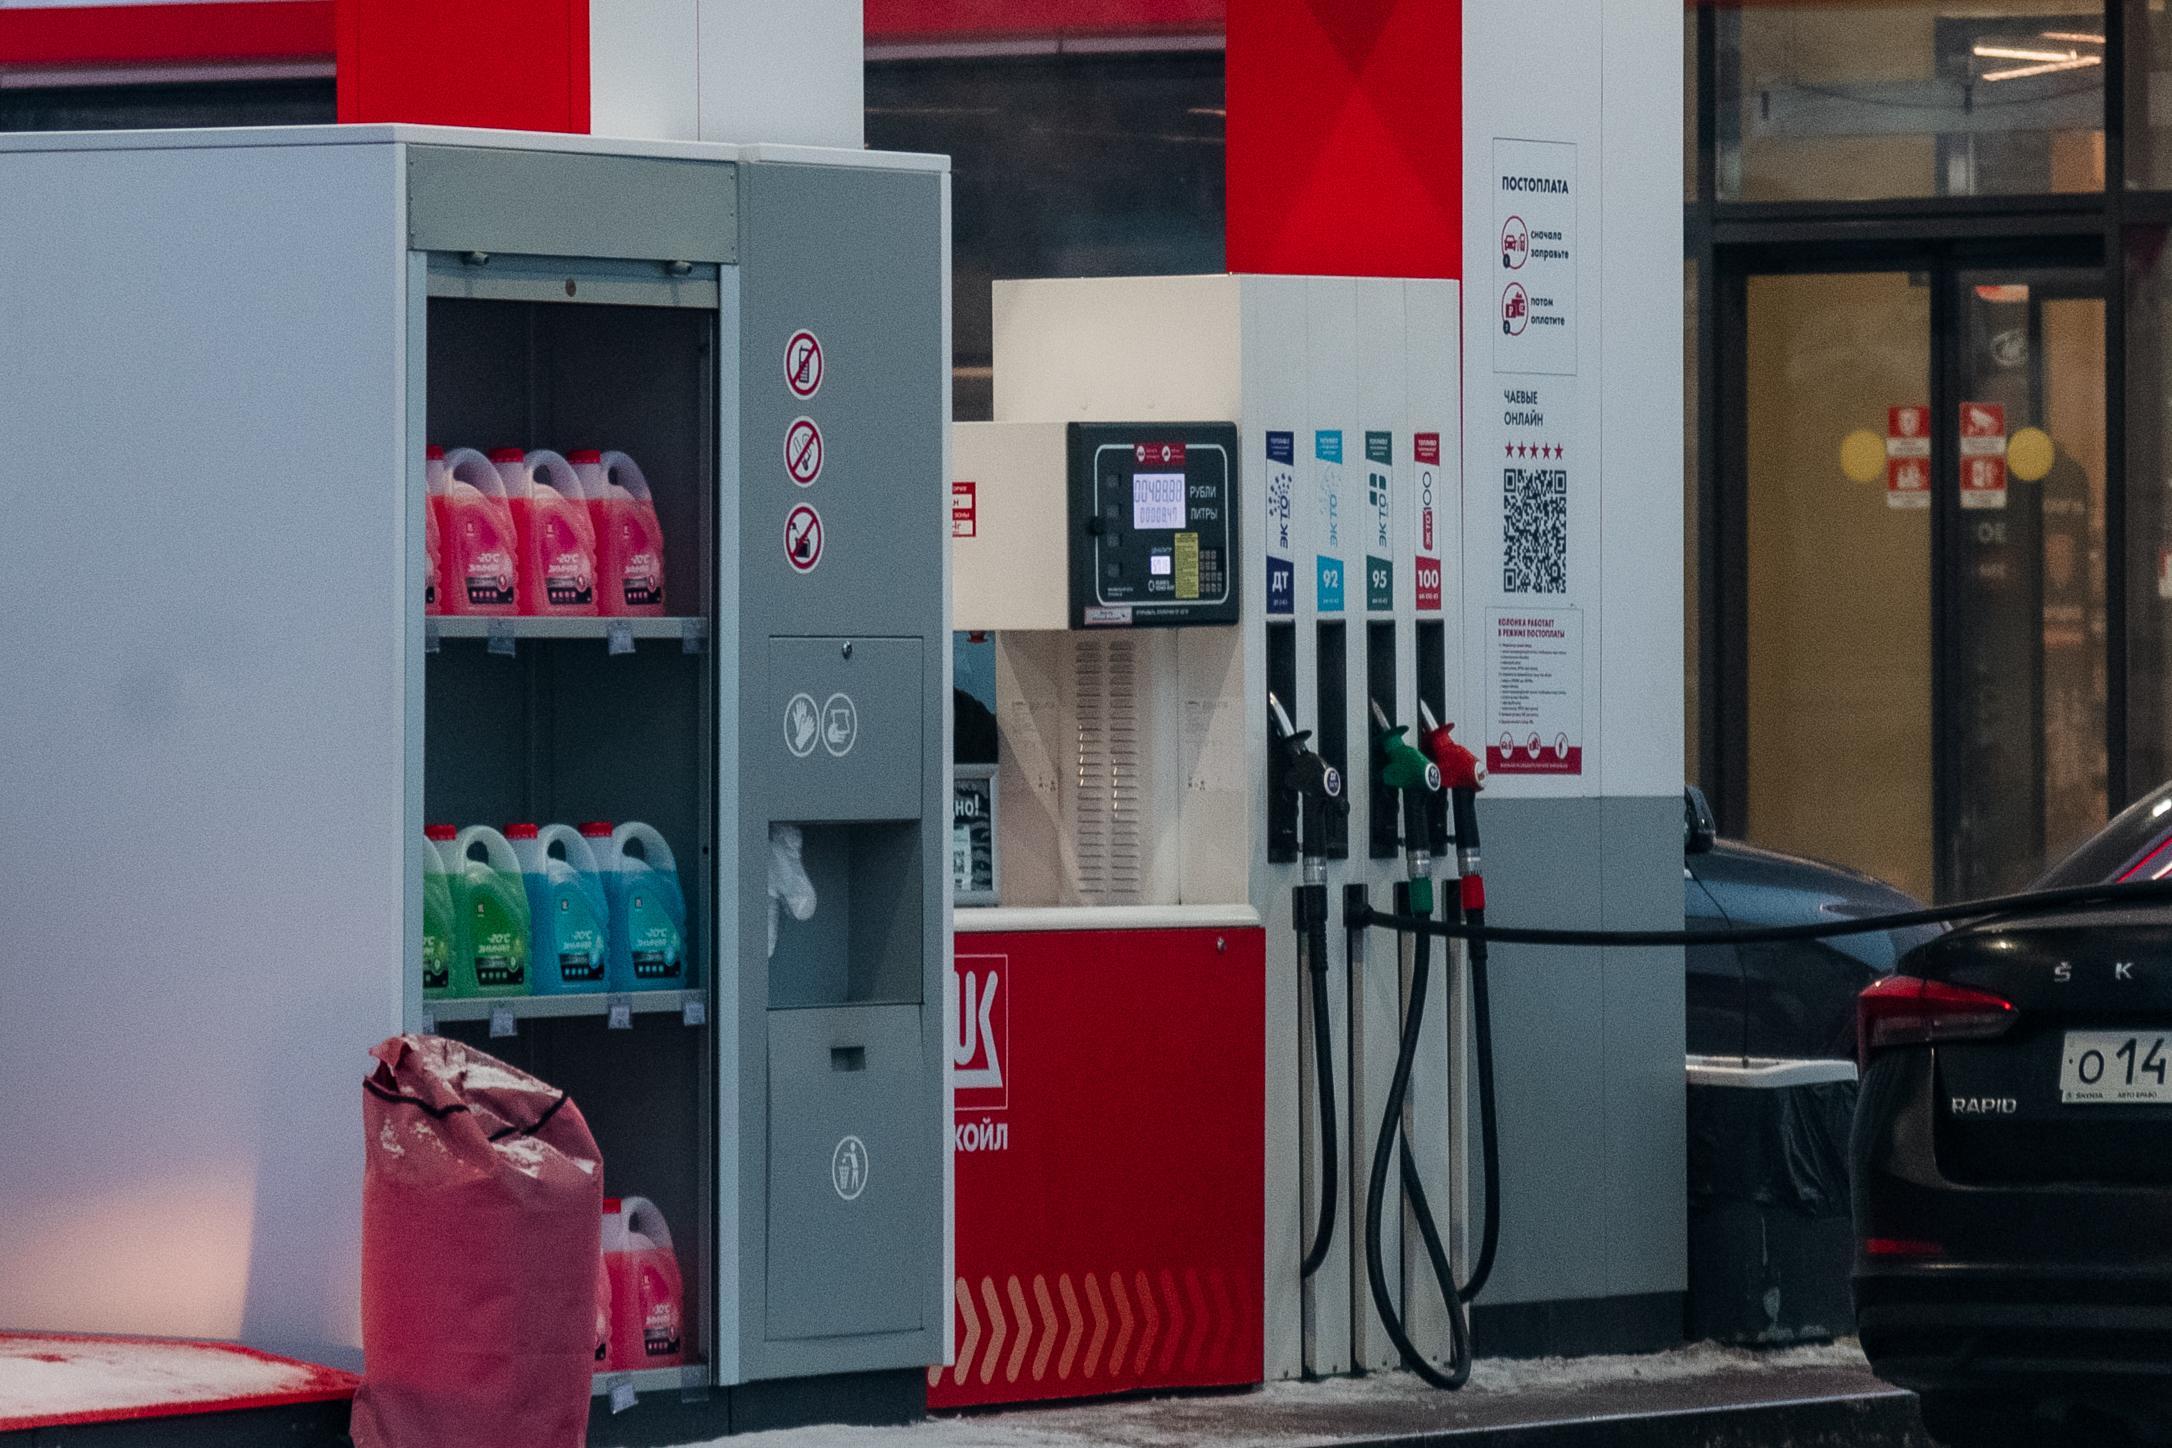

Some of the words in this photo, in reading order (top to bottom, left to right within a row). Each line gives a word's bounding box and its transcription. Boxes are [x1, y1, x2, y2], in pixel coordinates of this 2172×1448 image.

[1502, 176, 1569, 194] ПОСТОПЛАТА
[1530, 230, 1562, 241] сначала
[1530, 249, 1569, 262] заправьте
[1530, 297, 1553, 307] потом
[1530, 316, 1565, 326] оплатите
[1503, 390, 1538, 405] ЧАЕВЫЕ
[1503, 409, 1544, 426] ОНЛАЙН
[1189, 485, 1217, 498] РУБЛИ
[1190, 507, 1218, 520] ЛИТРЫ
[1280, 495, 1289, 549] ЭКТО
[1329, 494, 1338, 547] ЭКТО
[1378, 493, 1387, 548] ЭКТО
[1272, 571, 1289, 592] ДТ
[1323, 569, 1339, 588] 92
[1372, 569, 1387, 588] 95
[1418, 569, 1439, 588] 100
[1498, 618, 1526, 626] КОЛОНКА
[1527, 618, 1555, 628] РАБОТАЕТ
[1503, 628, 1526, 637] РЕЖИМЕ
[1527, 629, 1565, 638] ПОСТОПЛАТЫ
[1951, 1097, 2017, 1115] RAPID
